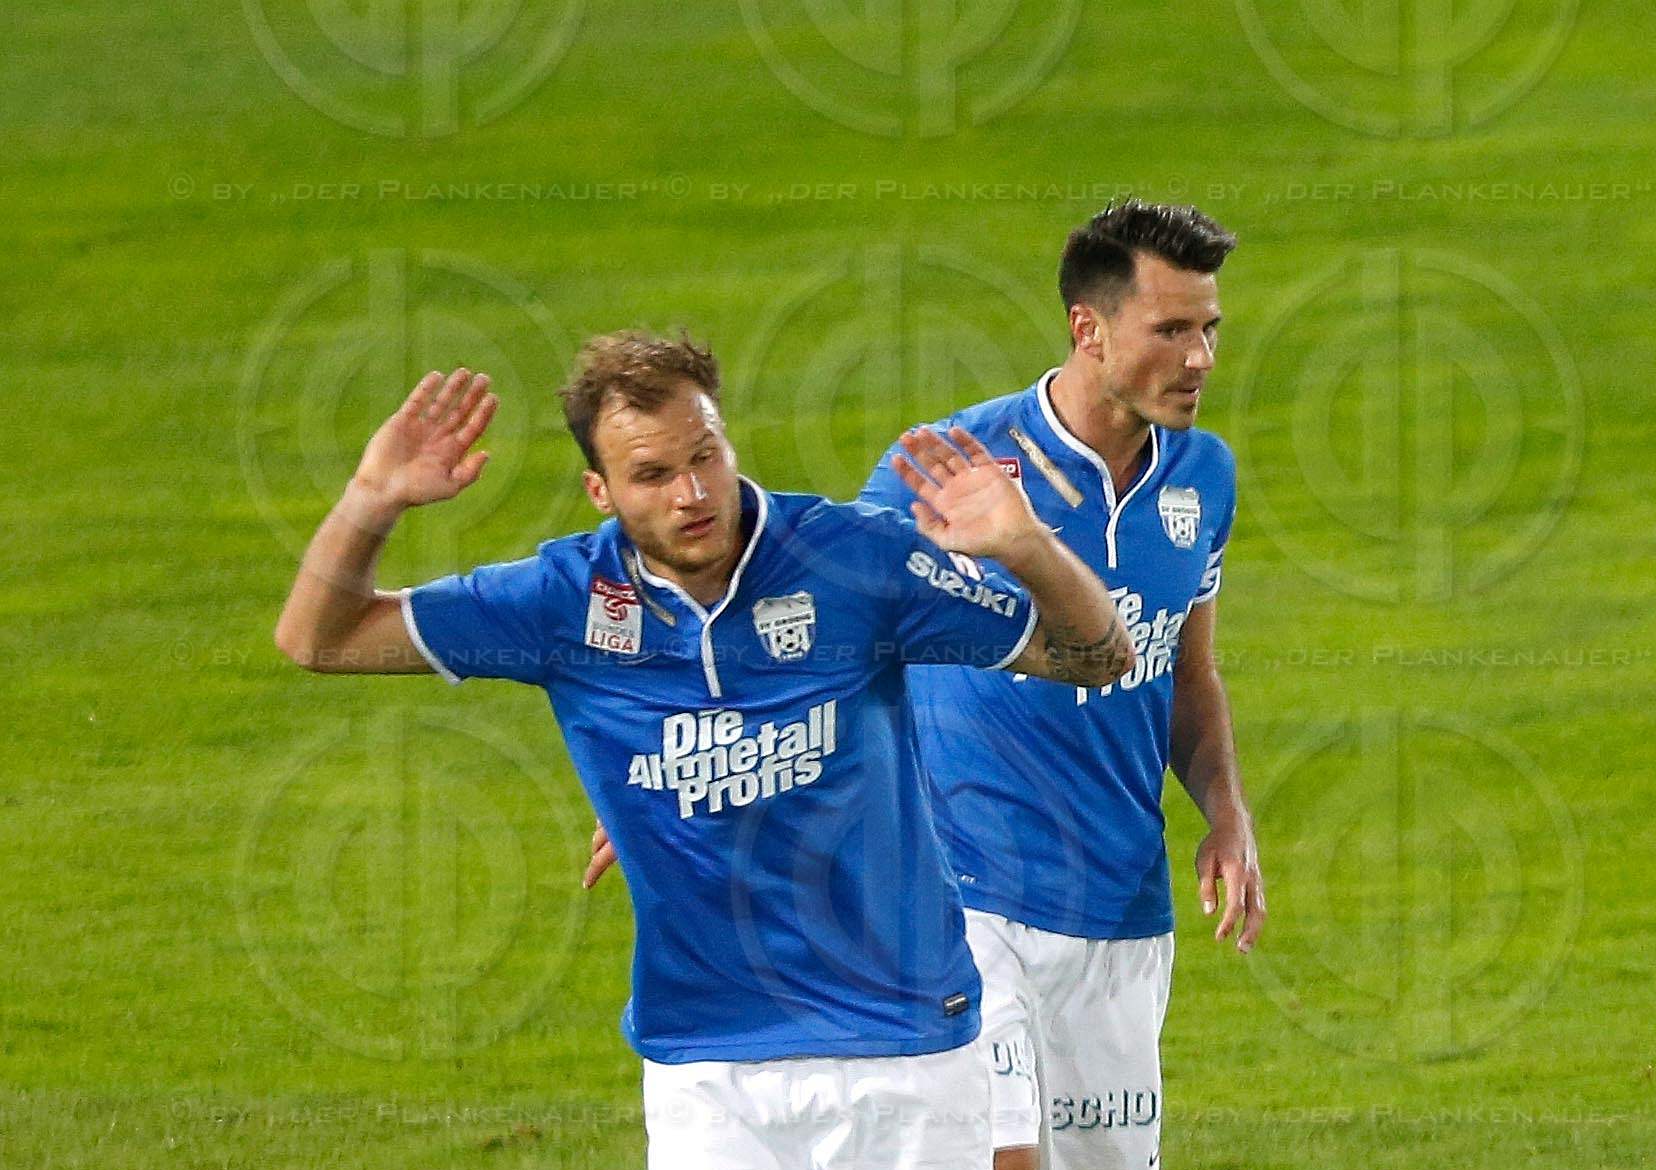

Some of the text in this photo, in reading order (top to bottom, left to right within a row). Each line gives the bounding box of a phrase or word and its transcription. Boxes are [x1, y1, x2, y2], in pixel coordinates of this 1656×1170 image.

[905, 550, 1018, 619] SUZUKI
[591, 630, 634, 651] LIGA
[663, 707, 744, 756] Die
[678, 750, 823, 819] Profis
[1051, 1086, 1158, 1130] SCHO
